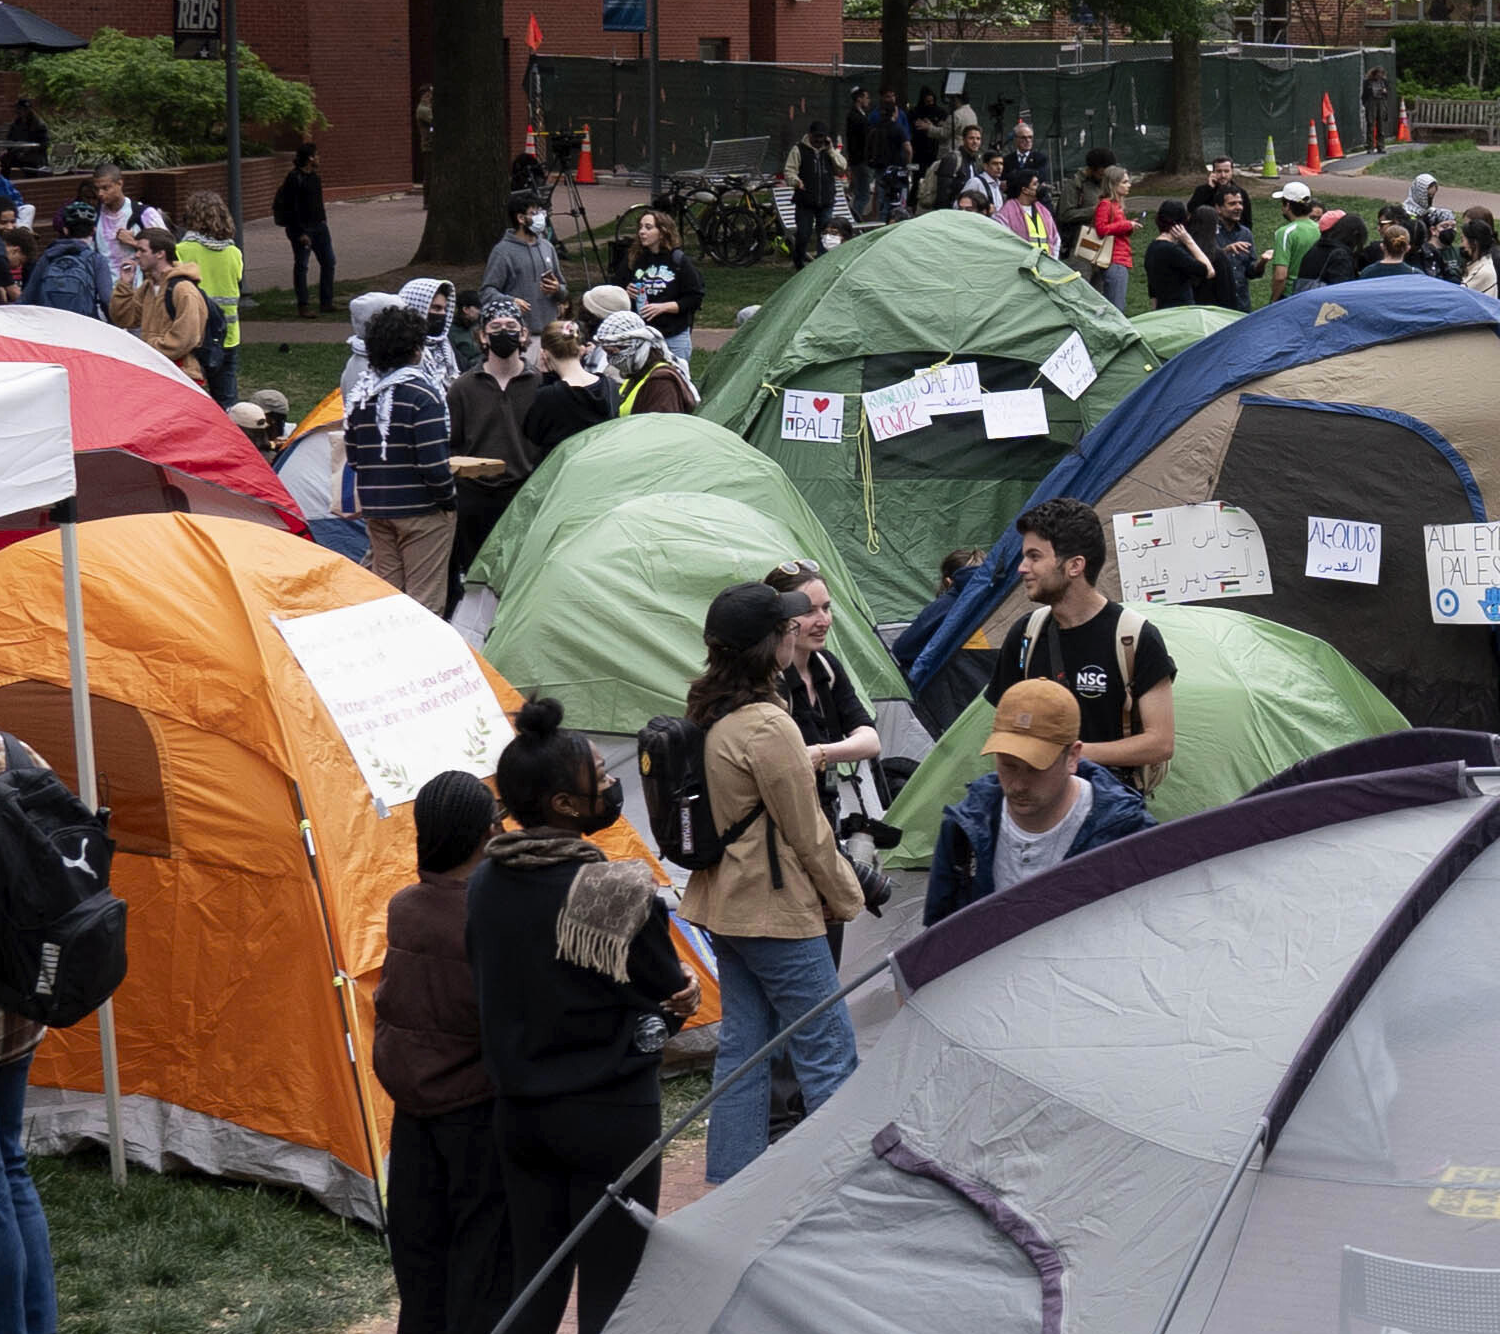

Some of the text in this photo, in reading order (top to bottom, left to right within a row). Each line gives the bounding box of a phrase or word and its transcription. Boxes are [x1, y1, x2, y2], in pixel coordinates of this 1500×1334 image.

[787, 394, 804, 415] I
[795, 416, 842, 440] PALI
[1308, 520, 1376, 554] AL-QUDS
[1427, 526, 1466, 552] ALL
[1076, 672, 1108, 686] NSC
